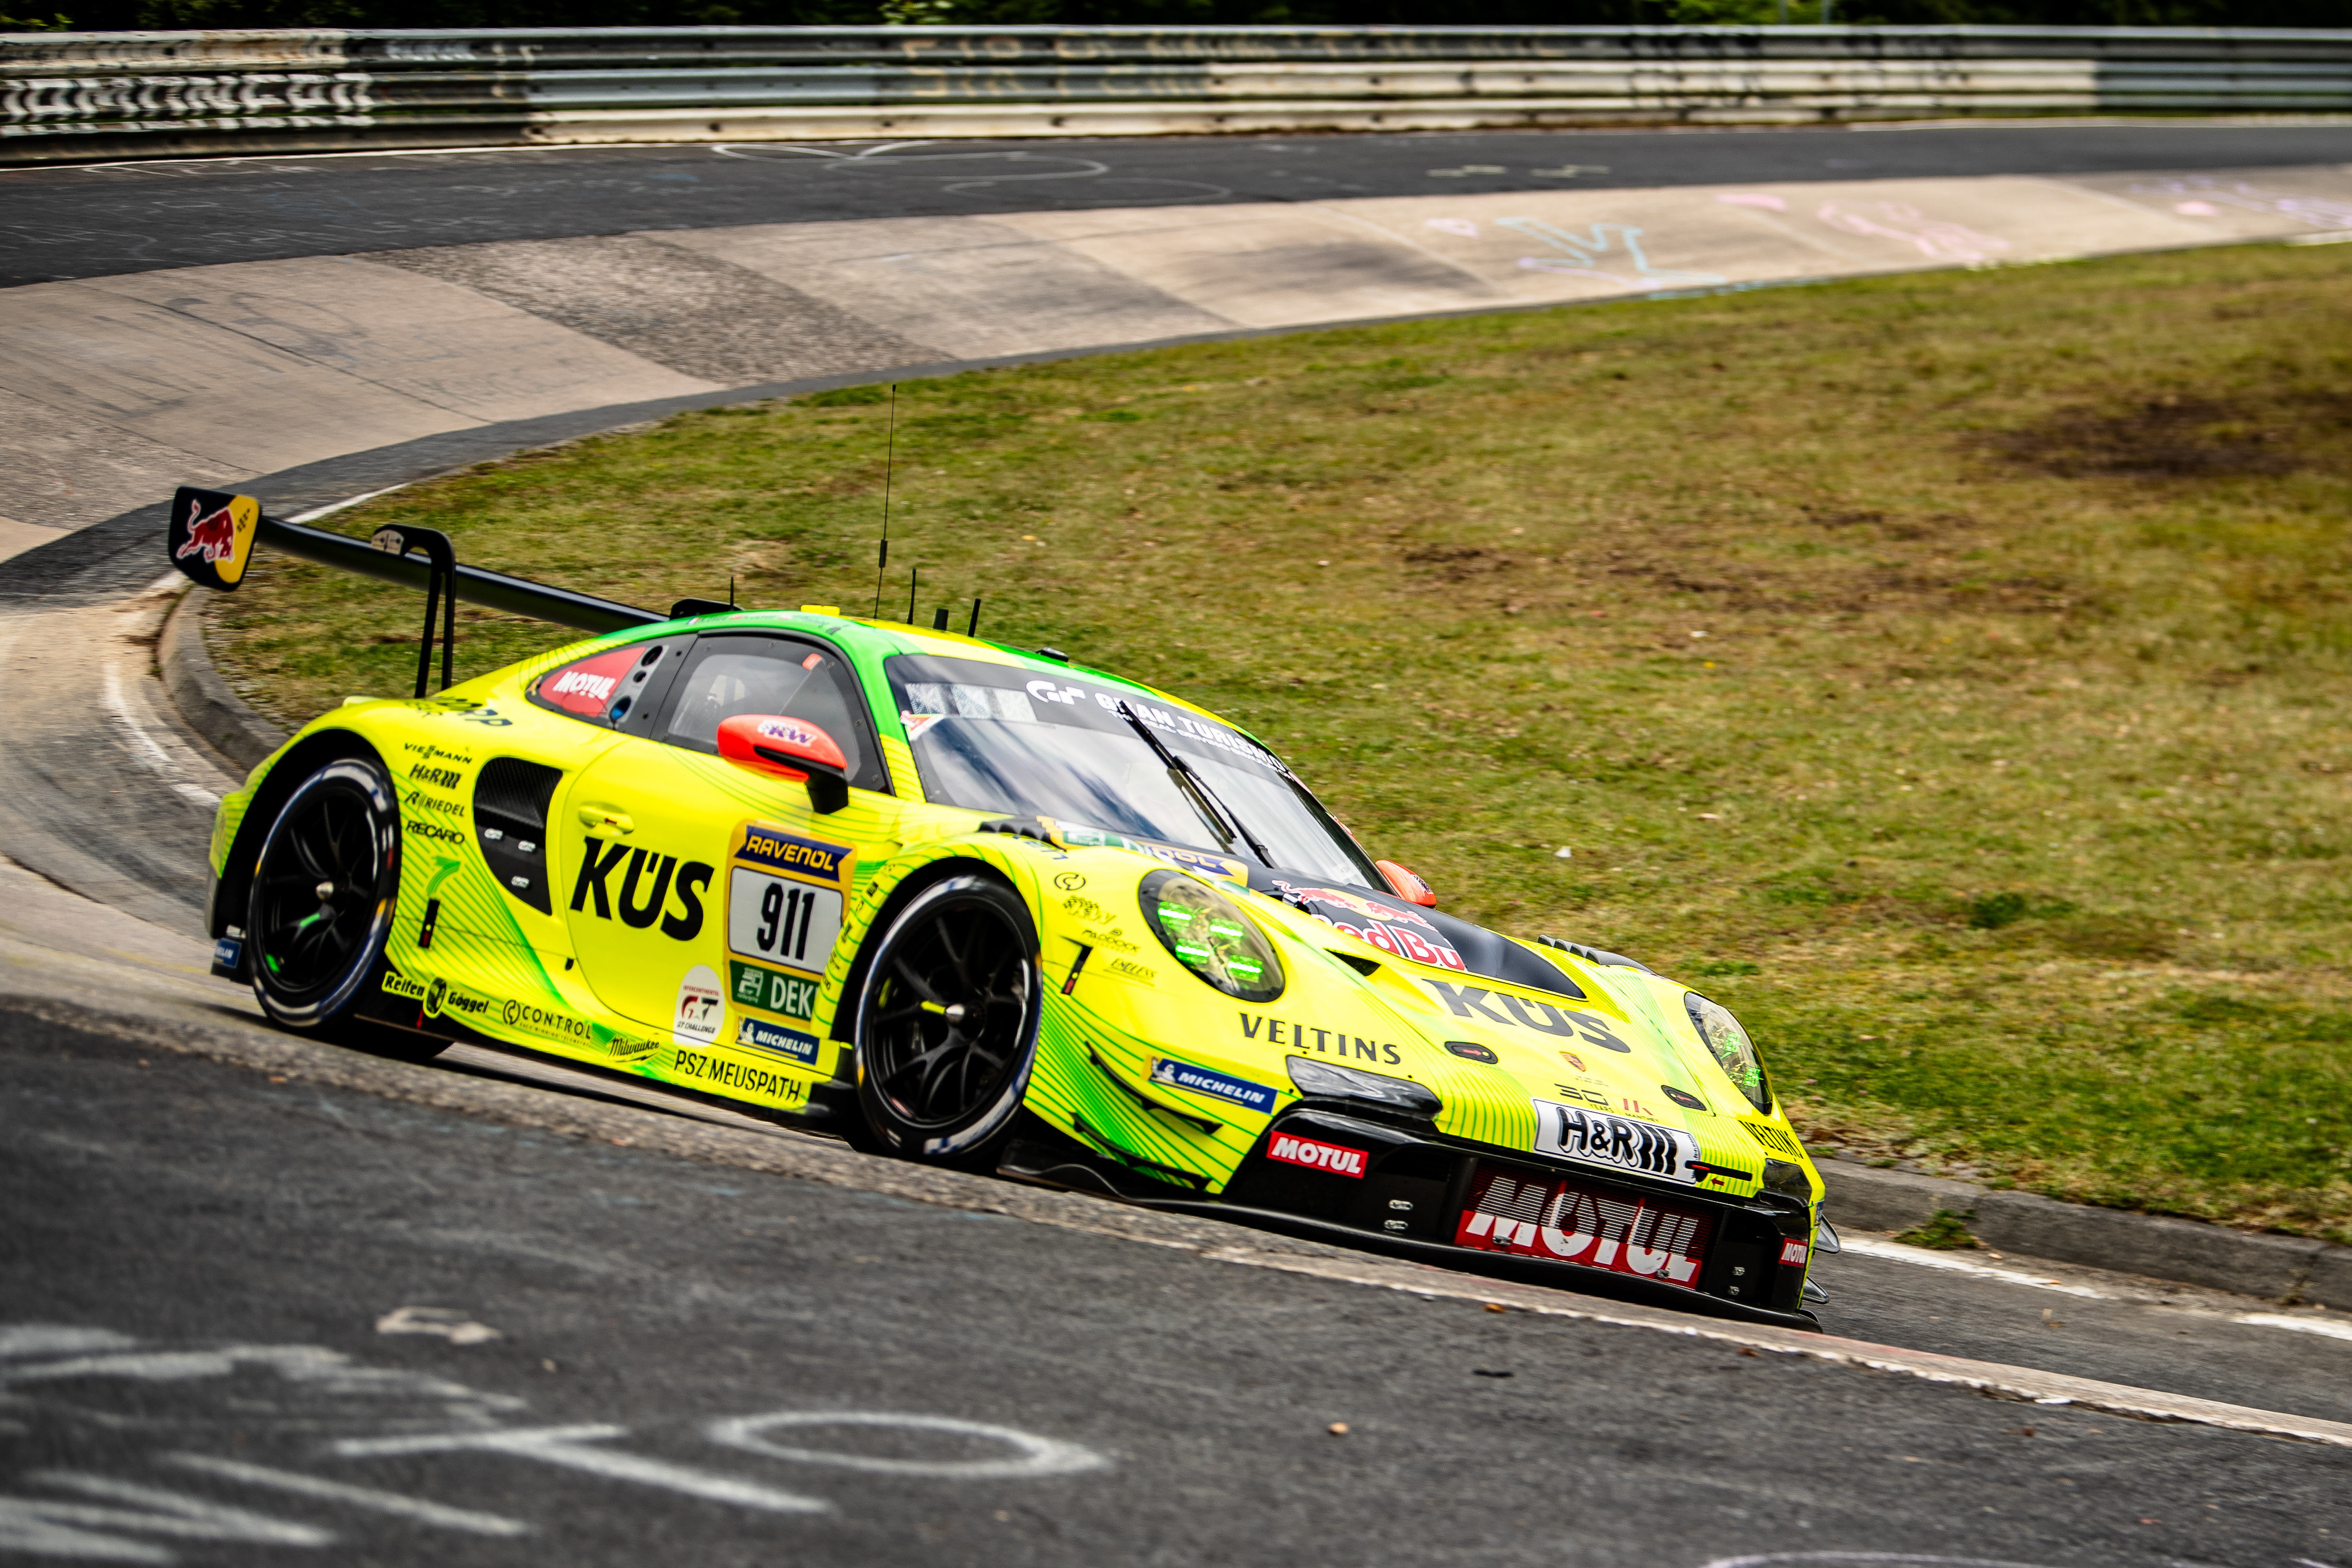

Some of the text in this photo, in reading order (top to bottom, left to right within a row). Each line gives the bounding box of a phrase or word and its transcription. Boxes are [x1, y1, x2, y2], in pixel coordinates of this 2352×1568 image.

[552, 671, 616, 700] MOTUL
[1094, 693, 1175, 728] GRAN
[1177, 716, 1286, 772] TURISMO
[424, 797, 465, 817] RIEDEL
[405, 820, 465, 845] RECARO
[746, 836, 834, 871] RAVENOL
[570, 836, 715, 941] KÜS
[757, 882, 815, 961] 911
[385, 975, 425, 996] Reifen
[522, 1005, 591, 1040] CONTROL
[1421, 978, 1631, 1053] KÜS
[608, 1035, 660, 1058] Milwaukee
[755, 1031, 813, 1055] MICHELIN
[1239, 1012, 1401, 1065] VELTINS
[674, 1050, 802, 1102] PSZ MEUSPATH
[1178, 1071, 1265, 1104] MICHELIN
[1271, 1137, 1361, 1174] MOTUL
[1556, 1106, 1639, 1168] H&R
[1737, 1120, 1804, 1159] VELTINS
[1465, 1175, 1699, 1282] MOTUL
